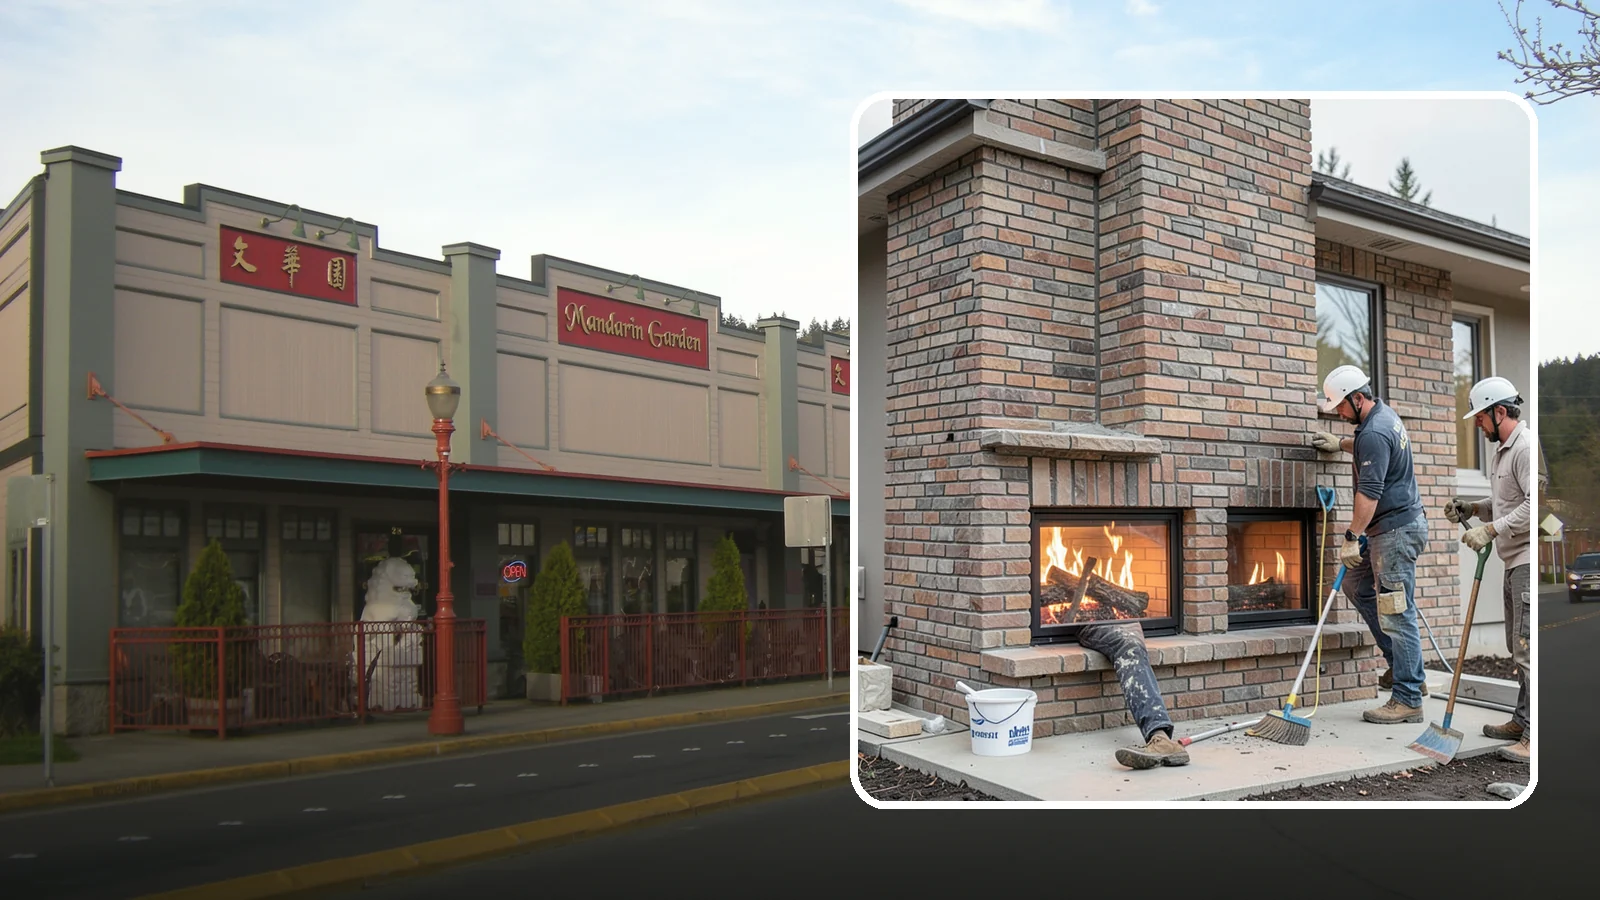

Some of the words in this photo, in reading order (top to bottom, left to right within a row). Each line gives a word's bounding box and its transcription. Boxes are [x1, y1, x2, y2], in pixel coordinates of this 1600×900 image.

[230, 235, 347, 291] 文華園
[564, 302, 644, 341] Mandarin
[647, 320, 701, 352] Garden
[834, 363, 846, 386] 文
[391, 526, 402, 535] 28
[503, 565, 527, 578] OPEN
